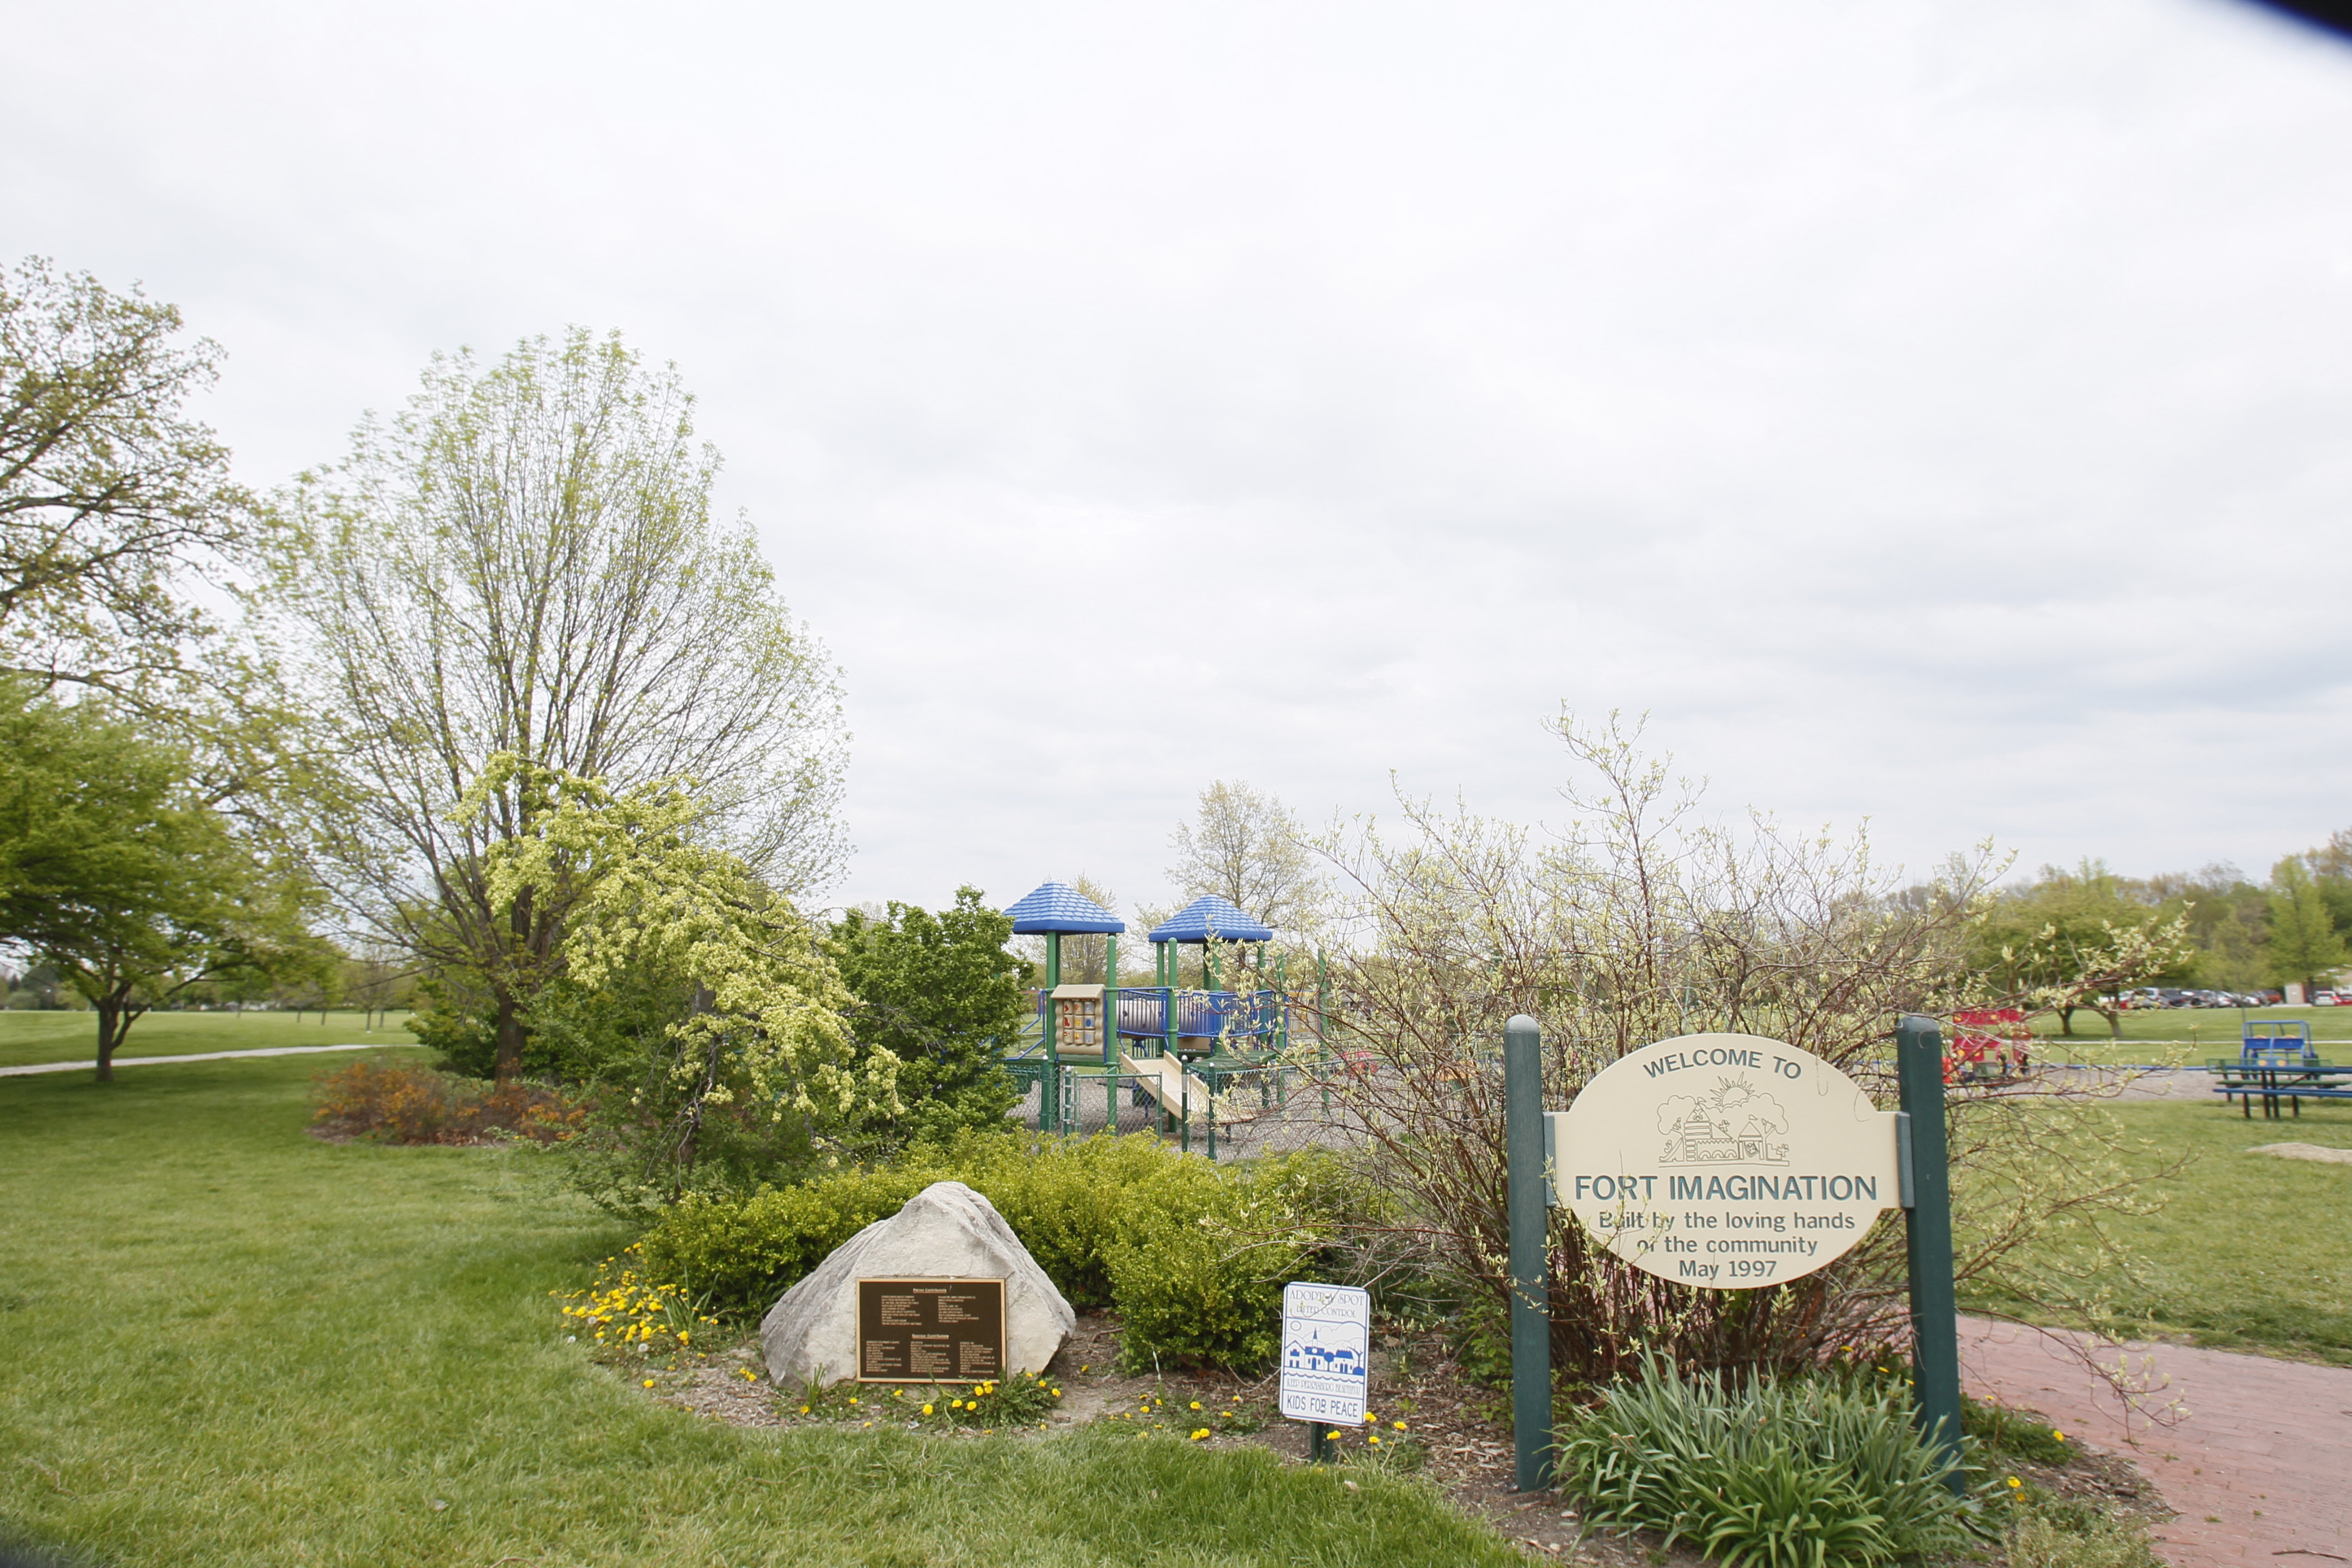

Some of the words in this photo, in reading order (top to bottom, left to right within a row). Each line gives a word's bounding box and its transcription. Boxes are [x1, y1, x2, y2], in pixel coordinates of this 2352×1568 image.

[1643, 1049, 1763, 1079] WELCOME
[1773, 1056, 1802, 1080] TO
[1575, 1175, 1658, 1201] FORT
[1669, 1175, 1877, 1201] IMAGINATION
[1684, 1211, 1718, 1229] the
[1725, 1211, 1786, 1233] loving
[1794, 1211, 1856, 1229] hands
[1664, 1235, 1698, 1253] the
[1706, 1236, 1818, 1257] community
[1679, 1260, 1720, 1281] May
[1728, 1260, 1778, 1277] 1997
[1289, 1289, 1324, 1301] ADOPT
[1338, 1293, 1364, 1306] SPOT
[1321, 1306, 1356, 1318] CONTROL
[1287, 1394, 1306, 1410] KIDS
[1309, 1397, 1327, 1413] FOR
[1330, 1400, 1358, 1418] PEACE
